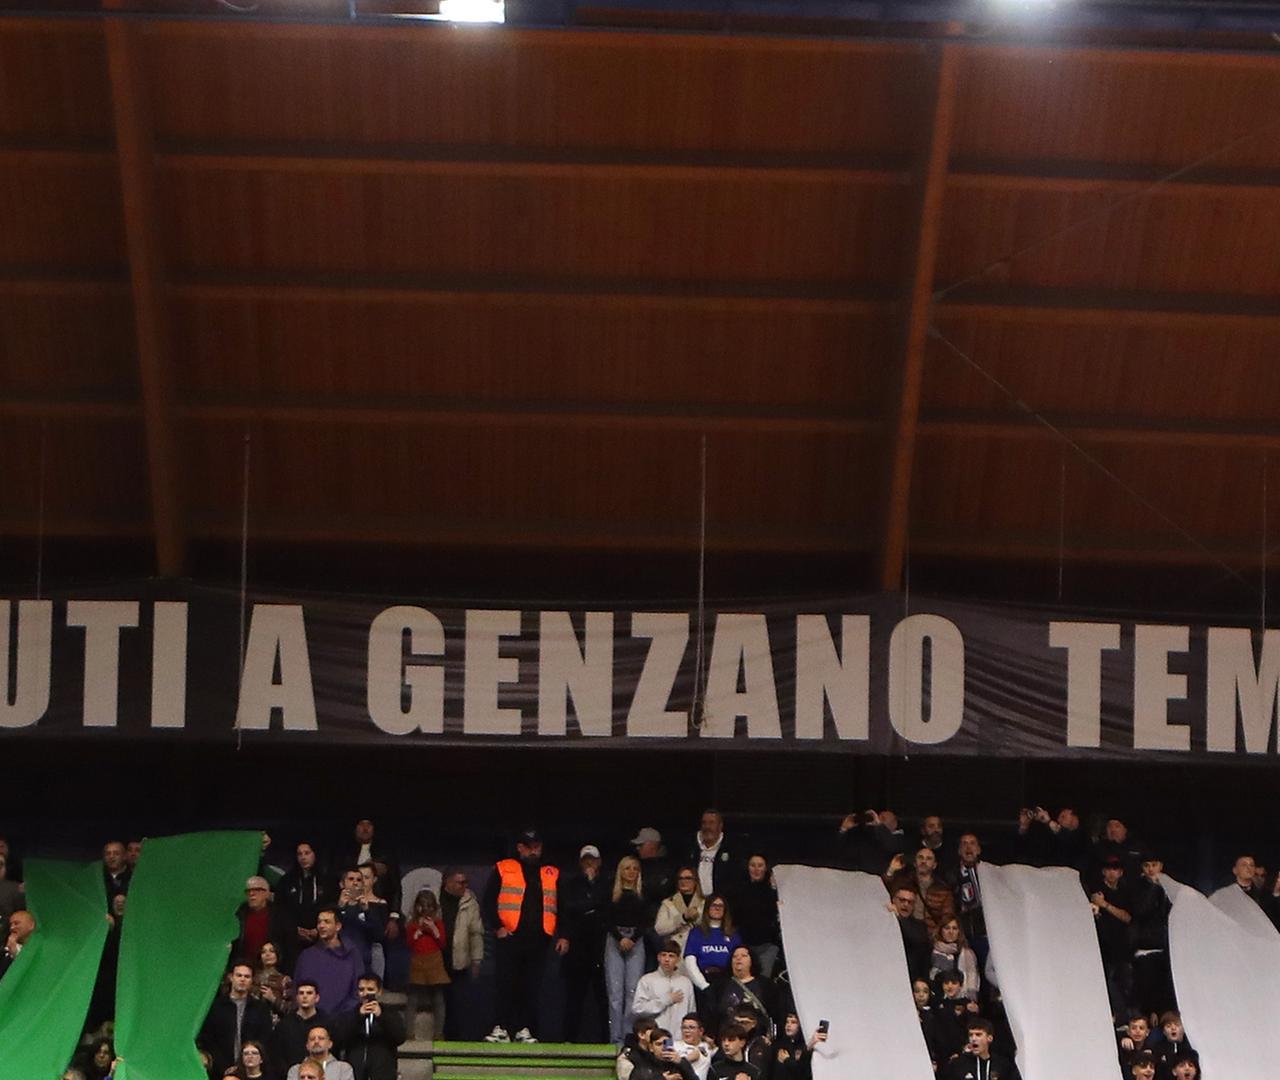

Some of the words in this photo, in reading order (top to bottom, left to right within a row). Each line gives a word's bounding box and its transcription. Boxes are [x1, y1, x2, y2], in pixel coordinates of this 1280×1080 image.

[239, 604, 319, 731] A
[366, 605, 966, 745] GENZANO
[702, 945, 728, 953] ITALIA
